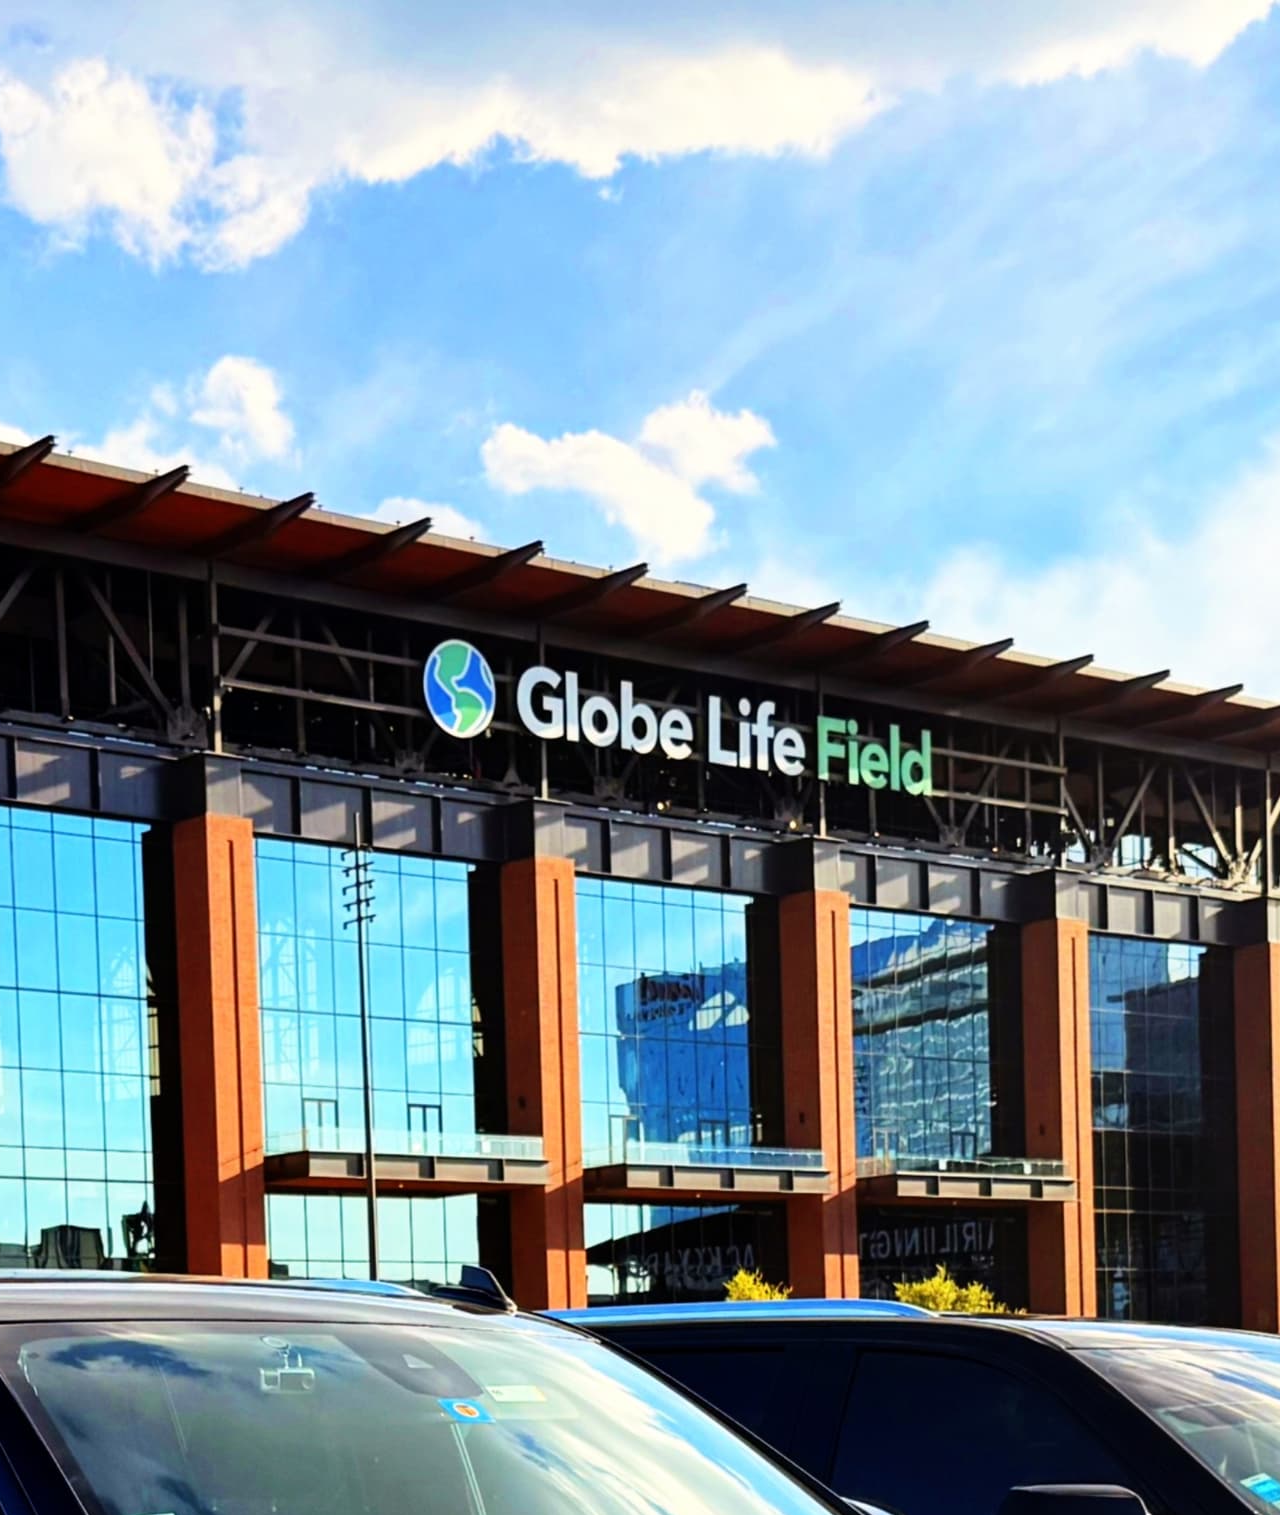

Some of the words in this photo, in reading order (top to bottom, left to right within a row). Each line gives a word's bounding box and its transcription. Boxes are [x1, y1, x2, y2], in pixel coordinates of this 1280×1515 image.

[516, 664, 694, 760] Globe
[707, 695, 807, 778] Life
[816, 715, 934, 797] Field
